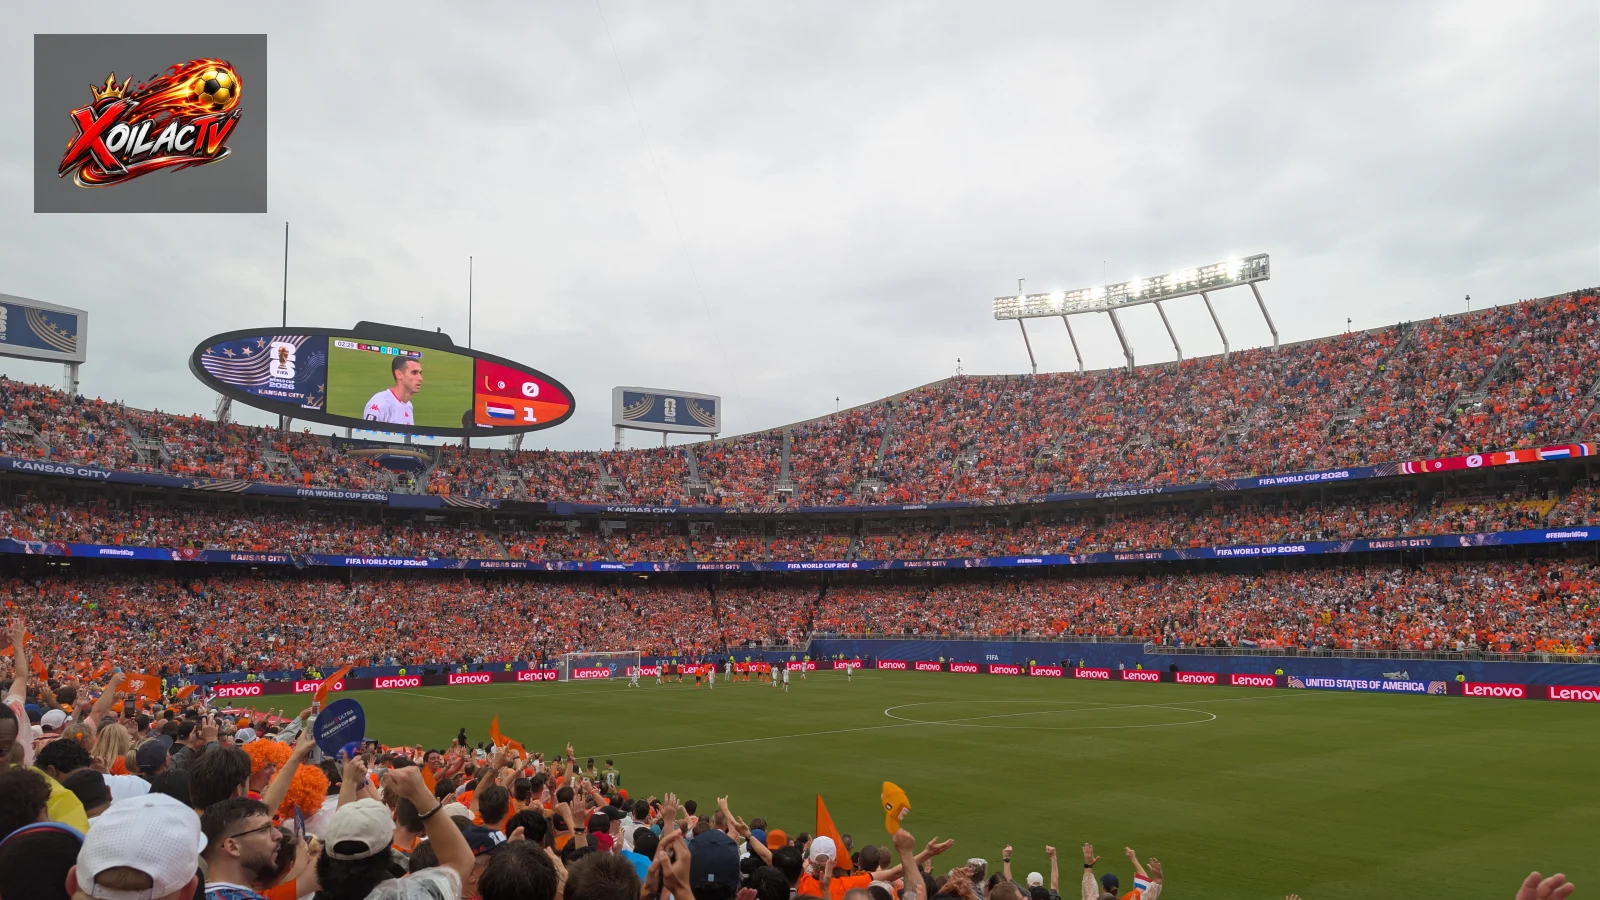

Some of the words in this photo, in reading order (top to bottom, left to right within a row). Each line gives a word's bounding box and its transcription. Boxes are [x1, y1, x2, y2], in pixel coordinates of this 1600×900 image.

[269, 382, 295, 390] 2026
[522, 382, 539, 397] 0
[258, 389, 287, 397] KANSAS
[523, 407, 537, 422] 1
[1466, 454, 1482, 468] 0
[1506, 452, 1520, 464] 1
[12, 460, 76, 475] KANSAS
[77, 467, 111, 479] CITY
[1276, 475, 1303, 484] WORLD
[1321, 471, 1349, 479] 2026
[316, 490, 344, 498] WORLD
[1096, 490, 1138, 498] KANSAS
[1546, 530, 1588, 540] #FIFAWorldCup
[1369, 539, 1408, 548] KANSAS
[1410, 538, 1432, 547] CITY
[231, 554, 266, 562] KANSAS
[879, 660, 906, 669] Lenovo
[916, 661, 941, 670] Lenovo
[951, 663, 977, 672] Lenovo
[574, 669, 609, 678] Lenovo
[990, 665, 1018, 675] Lenovo
[1075, 668, 1108, 679] Lenovo
[450, 674, 490, 684] Lenovo
[518, 671, 556, 681] Lenovo
[1123, 671, 1158, 681] Lenovo
[1176, 672, 1215, 684] Lenovo
[1232, 674, 1273, 686] Lenovo
[296, 681, 342, 692] Leno
[375, 677, 419, 688] Lenovo
[1305, 678, 1336, 688] UNITED
[1336, 679, 1368, 689] STATES
[1369, 680, 1381, 689] OF
[1382, 681, 1425, 692] AMERICA
[211, 686, 260, 697] enovo
[1465, 683, 1522, 697] Lenovo
